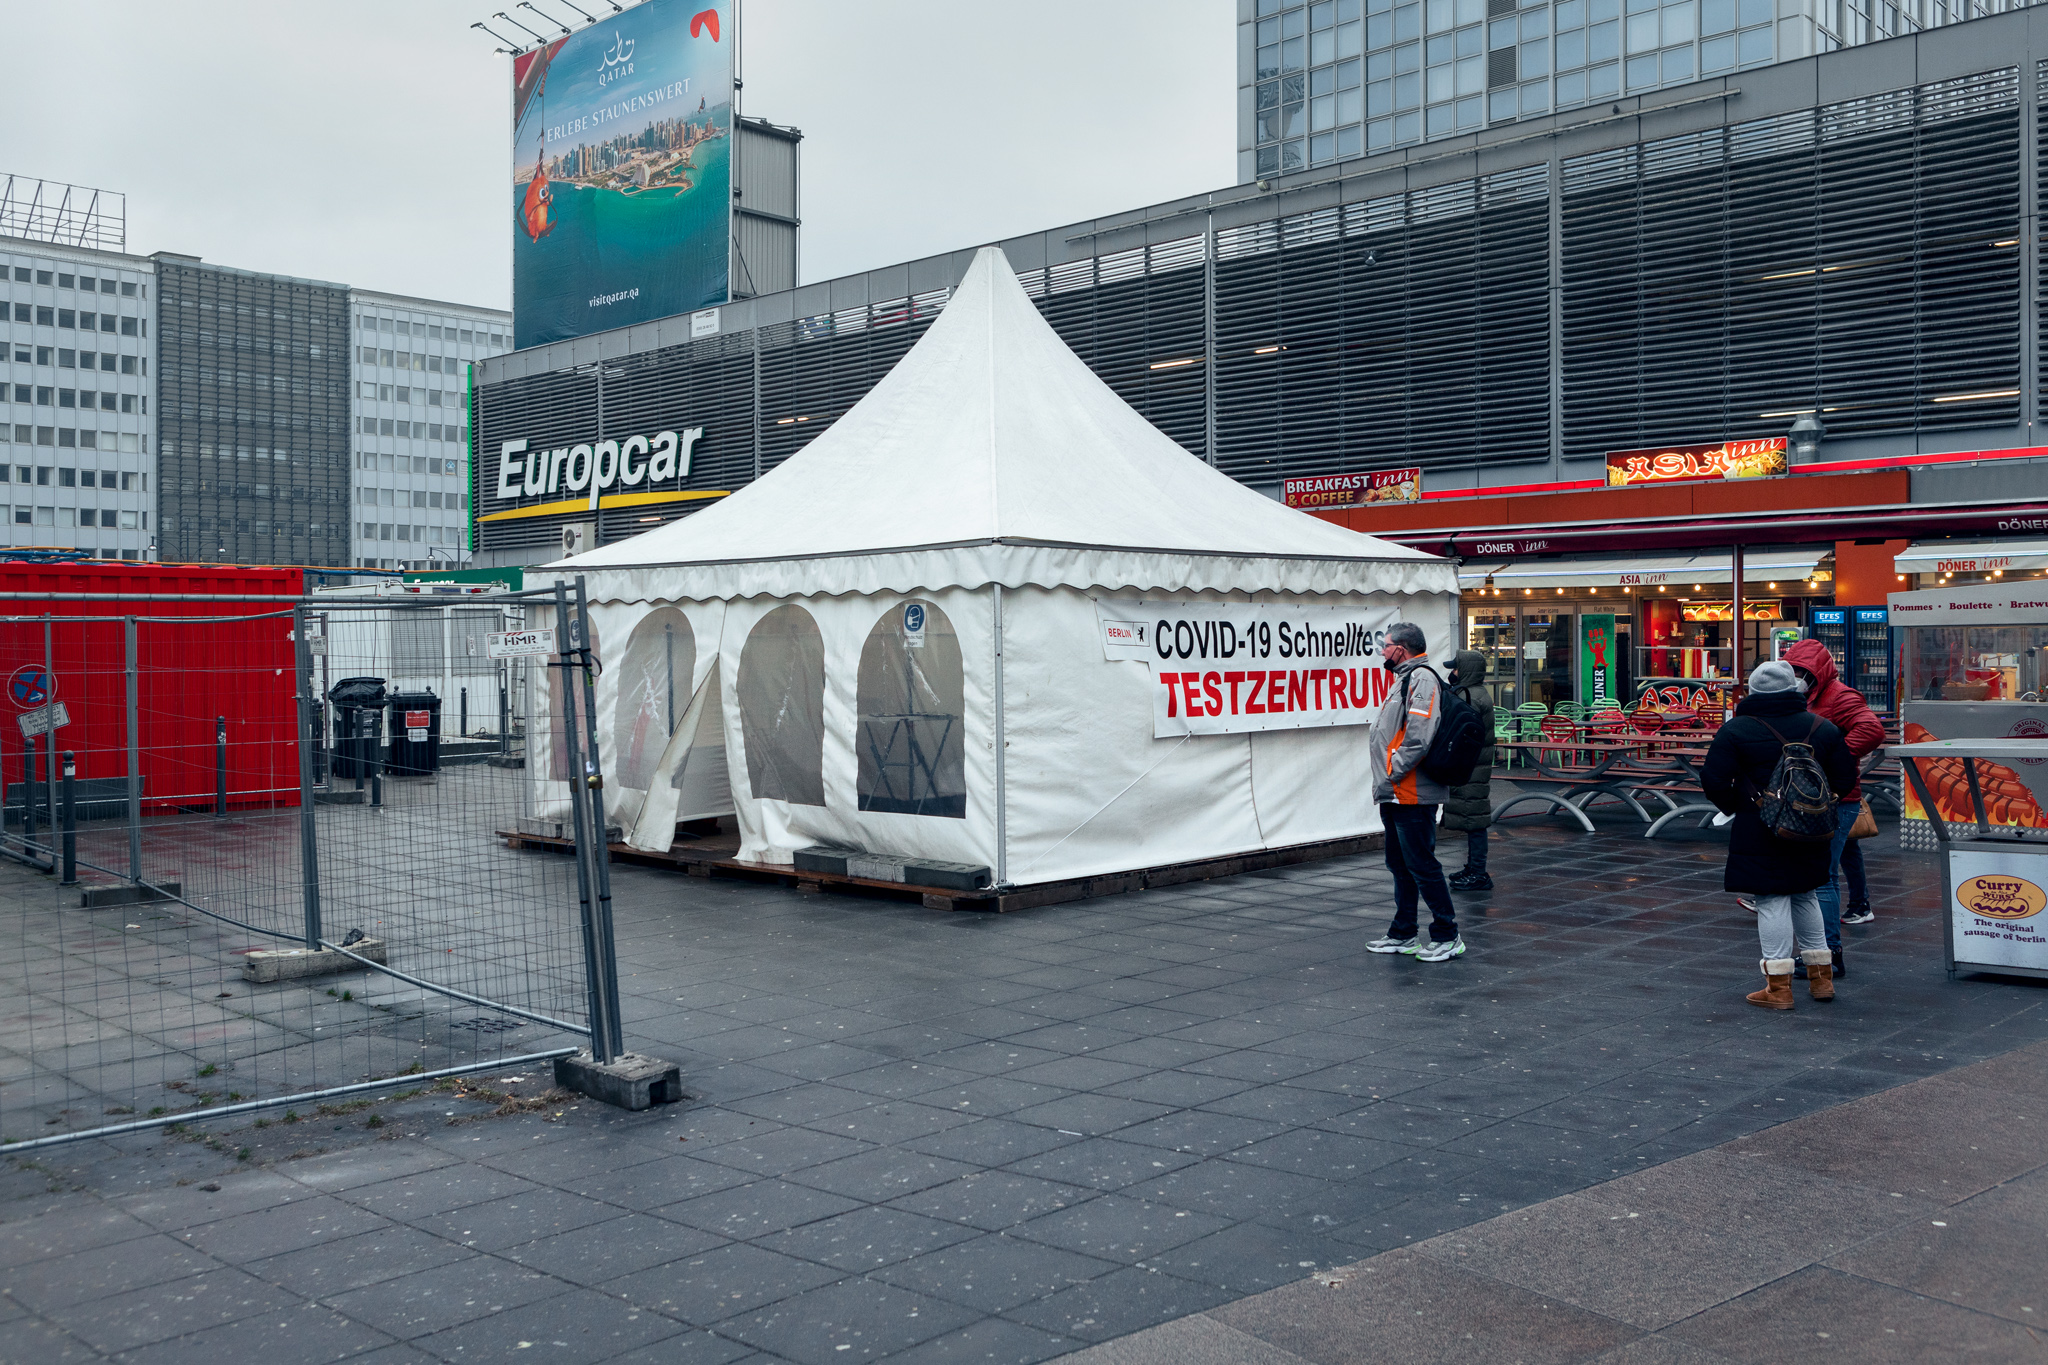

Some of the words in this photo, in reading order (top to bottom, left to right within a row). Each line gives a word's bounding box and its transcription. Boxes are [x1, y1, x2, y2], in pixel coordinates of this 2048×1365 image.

[599, 63, 634, 86] QATAR
[547, 115, 588, 142] ERLEBE
[592, 78, 691, 127] STAUNENSWERT
[589, 288, 639, 307] visitqatar.qa
[1626, 450, 1730, 480] ASIA
[1731, 438, 1782, 458] inn
[497, 427, 705, 510] Europcar
[1286, 475, 1370, 494] BREAKFAST
[1375, 470, 1414, 487] inn
[1288, 494, 1298, 507] &
[1300, 490, 1354, 506] COFFEE
[1477, 542, 1515, 554] DÖNER
[1525, 540, 1548, 552] inn
[1937, 559, 1976, 572] DÖNER
[1983, 557, 2012, 570] inn
[1619, 574, 1641, 585] ASIA
[1645, 573, 1668, 585] inn
[1893, 603, 1933, 612] Pommes
[1949, 601, 1993, 610] Boulette
[1819, 612, 1840, 620] EFES
[1108, 627, 1132, 638] BERLIN
[1155, 619, 1271, 660] COVID-19
[1279, 621, 1391, 659] Schnelltes
[504, 635, 537, 646] HMR
[1159, 667, 1395, 718] TESTZENTRUM
[1639, 685, 1710, 711] ASIA
[2013, 720, 2046, 732] ORIGINAL
[1976, 879, 2023, 893] Curry
[1983, 891, 2016, 900] WURST
[1995, 922, 2034, 933] original
[1964, 930, 2001, 939] sausage
[2003, 933, 2014, 941] of
[2016, 934, 2047, 943] berlin
